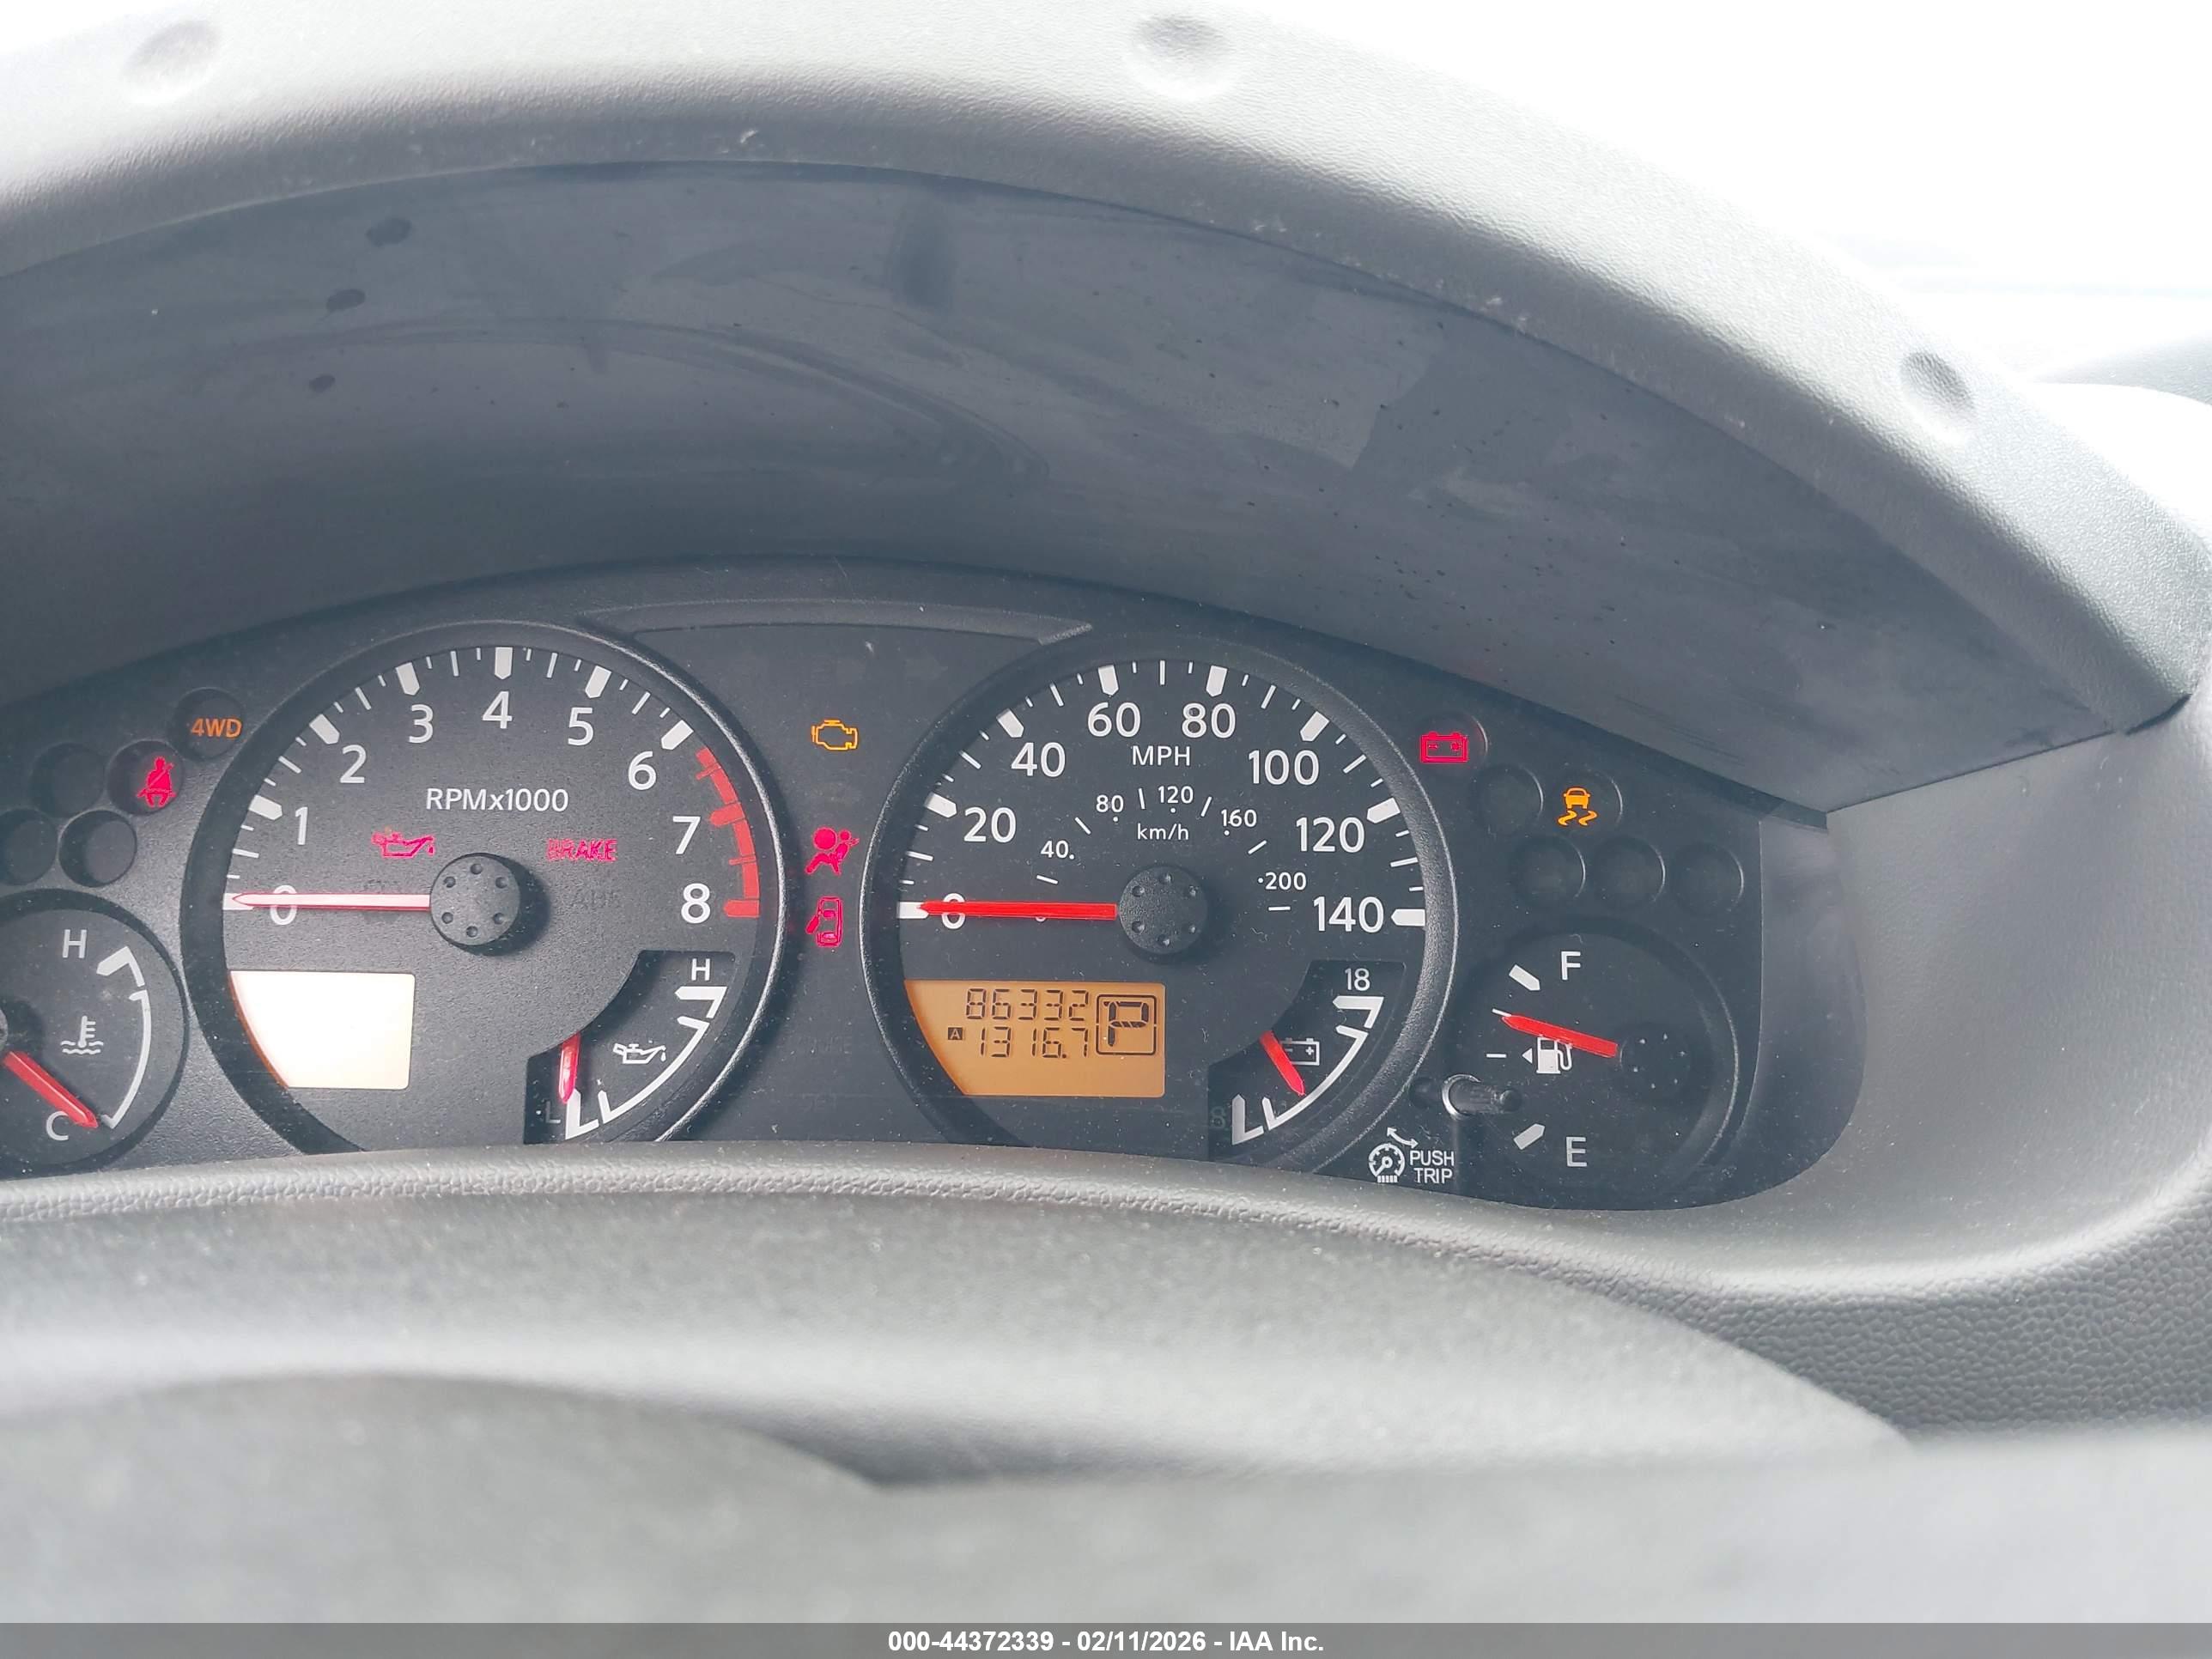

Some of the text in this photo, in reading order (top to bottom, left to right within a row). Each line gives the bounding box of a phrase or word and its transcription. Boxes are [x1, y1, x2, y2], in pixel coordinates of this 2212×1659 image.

[409, 704, 433, 743] 3
[483, 691, 512, 728] 4
[1088, 702, 1140, 737] 60
[1182, 703, 1235, 738] 80
[191, 718, 242, 738] 4WD
[568, 708, 593, 745] 5
[340, 745, 366, 783] 2
[629, 751, 656, 790] 6
[1012, 743, 1065, 776] 40
[1133, 746, 1189, 765] MPH
[1249, 750, 1318, 785] 100
[427, 788, 568, 811] RPMx1000
[1097, 795, 1123, 812] 80
[1158, 787, 1193, 803] 120
[295, 807, 307, 845] 1
[964, 807, 1016, 842] 20
[1138, 823, 1188, 840] km/h
[1221, 810, 1256, 827] 160
[673, 817, 700, 854] 7
[1041, 841, 1068, 858] 40
[1297, 817, 1364, 853] 120
[549, 840, 616, 861] BRAKE
[1266, 872, 1306, 890] 200
[681, 884, 710, 923] 8
[1314, 896, 1383, 933] 140
[63, 929, 87, 958] H
[691, 958, 709, 981] H
[1346, 969, 1370, 991] 18
[1561, 951, 1580, 980] F
[966, 988, 1089, 1021] 86332
[1105, 1001, 1149, 1047] P
[949, 1026, 1088, 1058] A 1316.7
[46, 1111, 68, 1140] C
[1410, 1151, 1455, 1166] PUSH
[1566, 1137, 1587, 1166] E
[1414, 1168, 1452, 1183] TRIP
